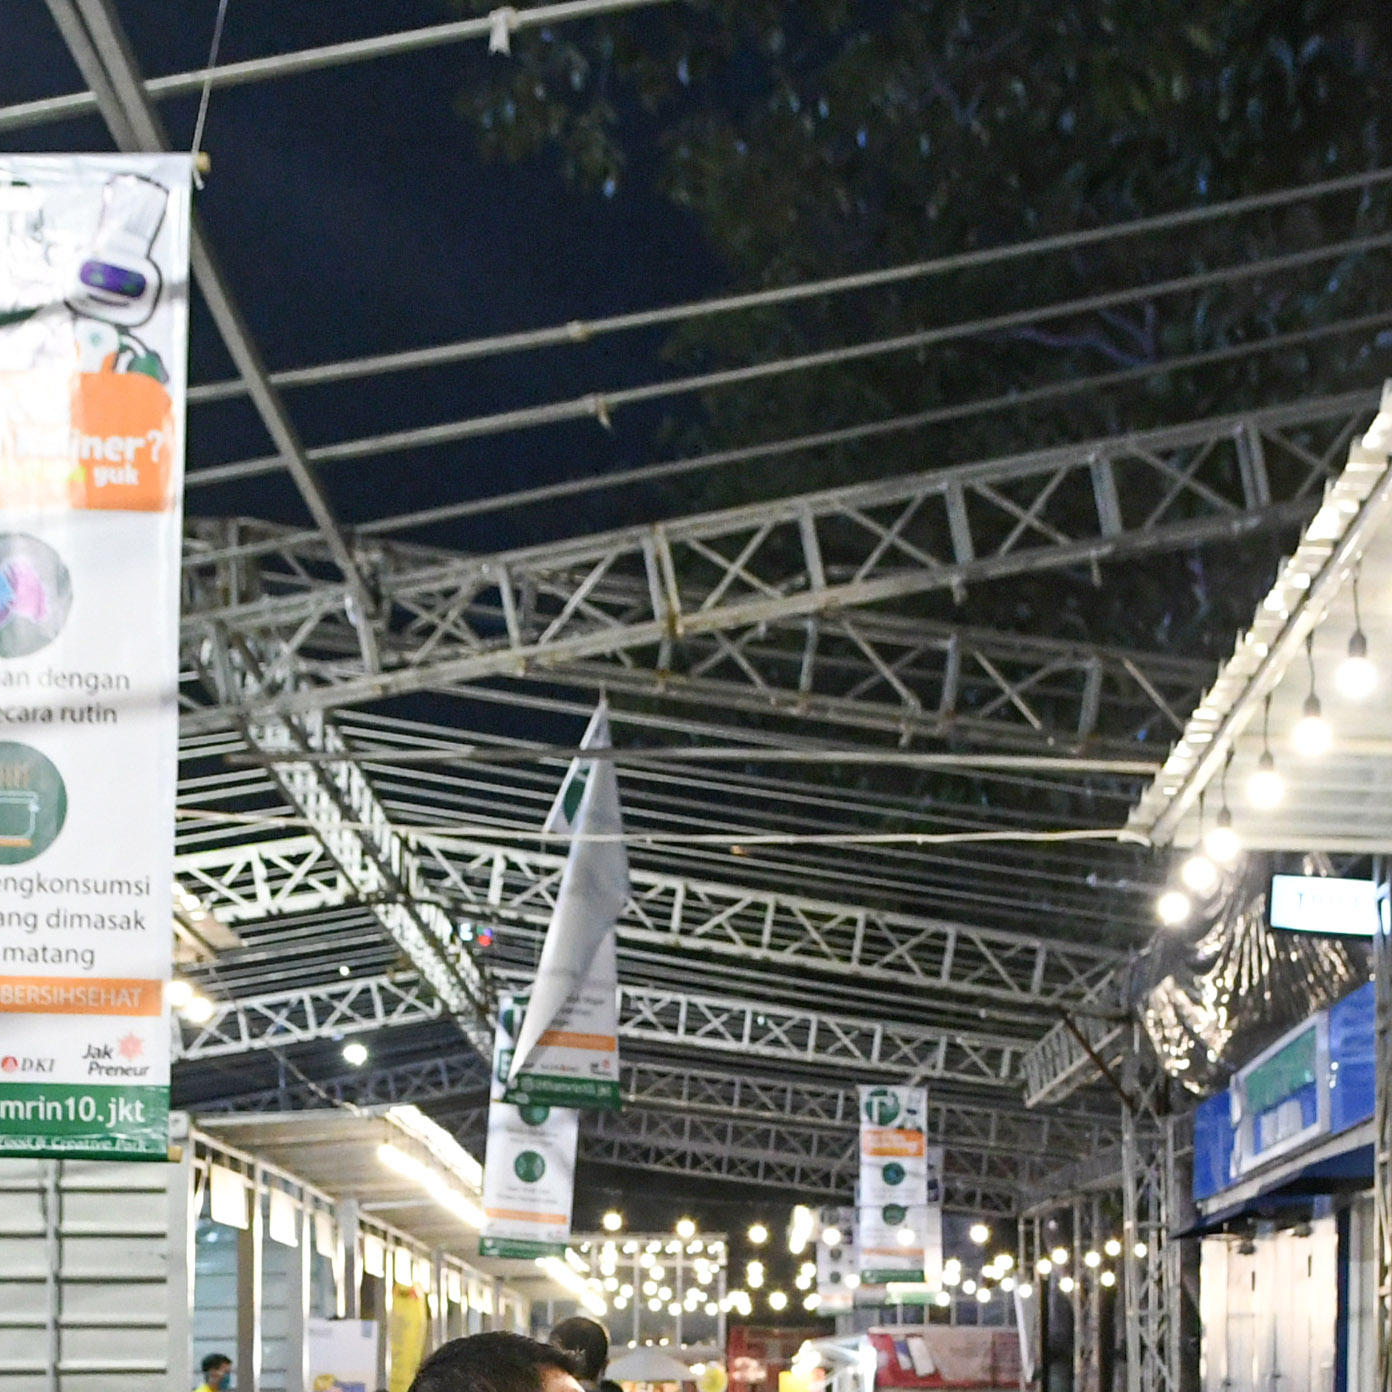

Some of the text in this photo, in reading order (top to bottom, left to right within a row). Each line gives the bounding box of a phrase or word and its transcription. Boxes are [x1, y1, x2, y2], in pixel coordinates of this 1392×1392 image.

[37, 665, 130, 696] dengan
[60, 702, 118, 724] rutin
[45, 906, 146, 931] dimasak
[2, 943, 95, 969] matang
[82, 1044, 113, 1060] Jak
[20, 1057, 56, 1073] DKI
[88, 1061, 150, 1078] Preneur
